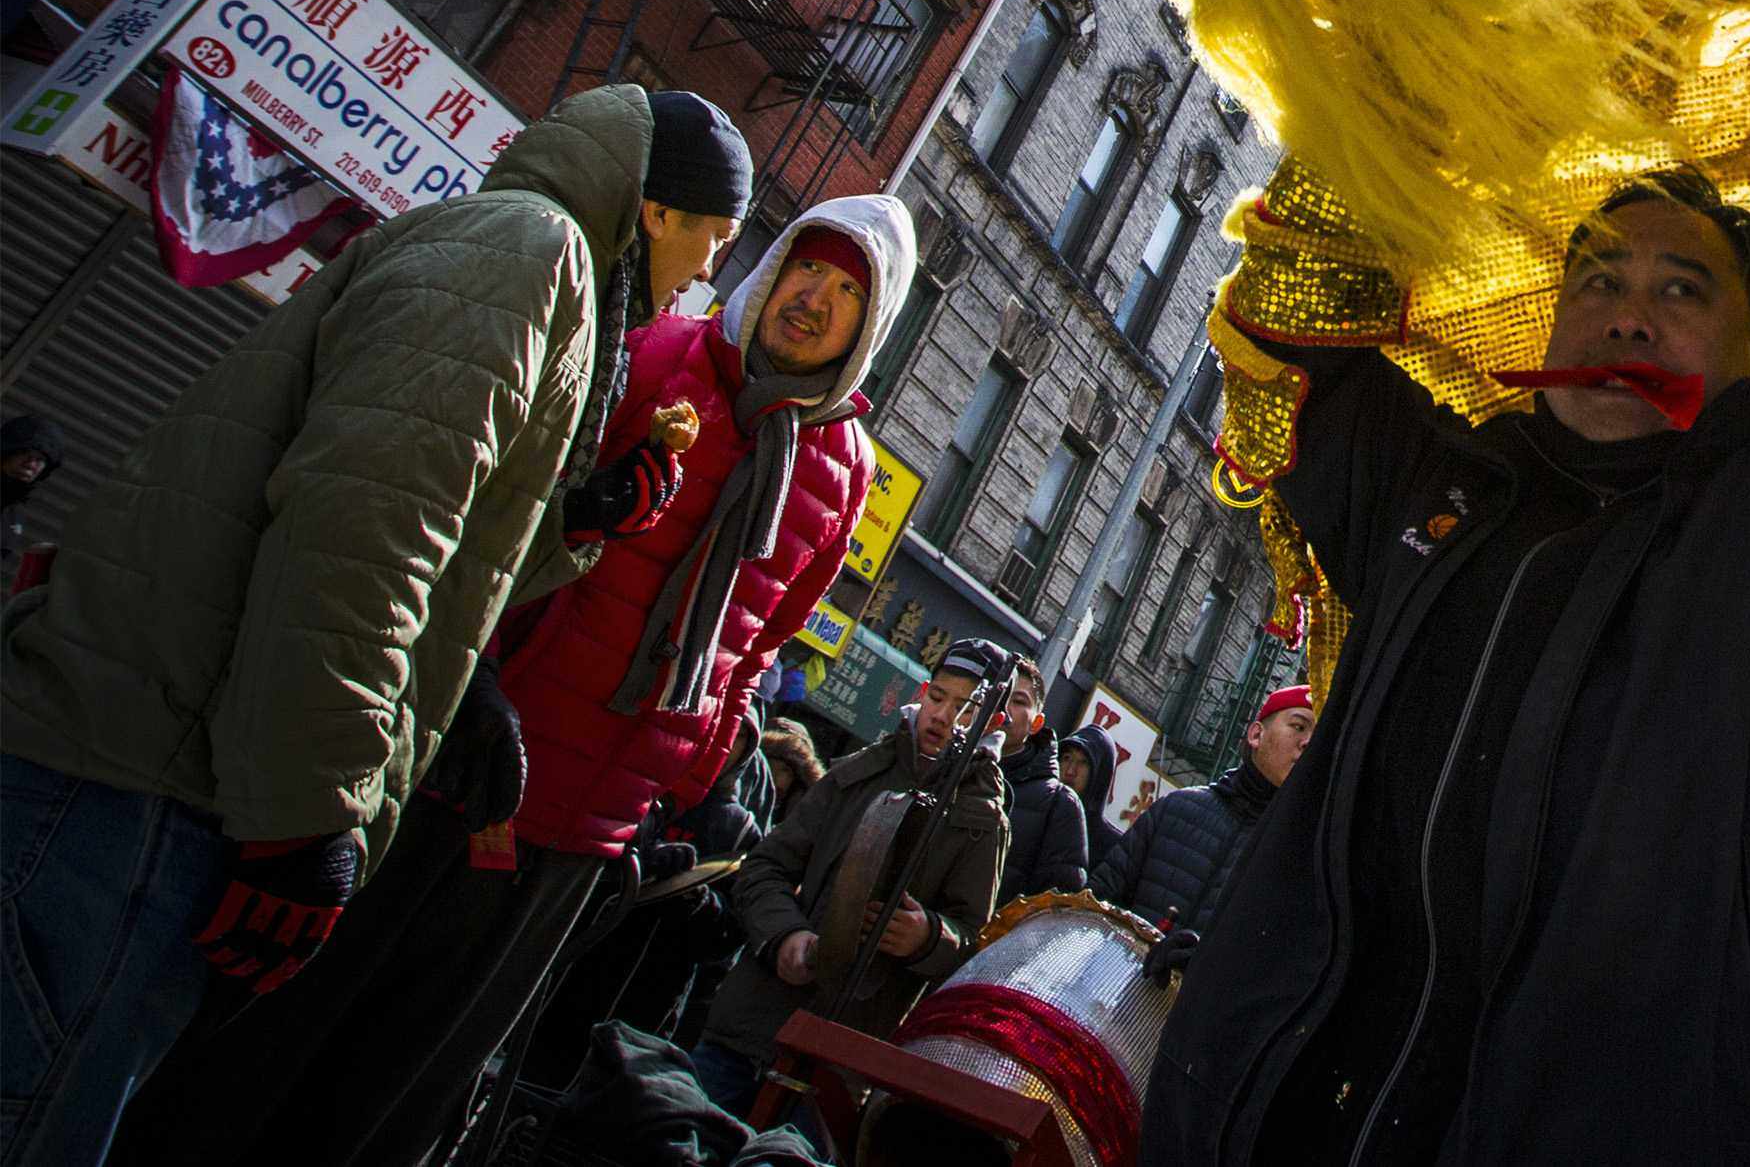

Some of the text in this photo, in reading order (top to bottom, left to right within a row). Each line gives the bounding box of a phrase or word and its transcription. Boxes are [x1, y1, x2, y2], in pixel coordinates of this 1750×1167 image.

[190, 37, 230, 79] 82b
[218, 0, 421, 176] canalberry
[240, 79, 324, 150] MULBERRY ST.
